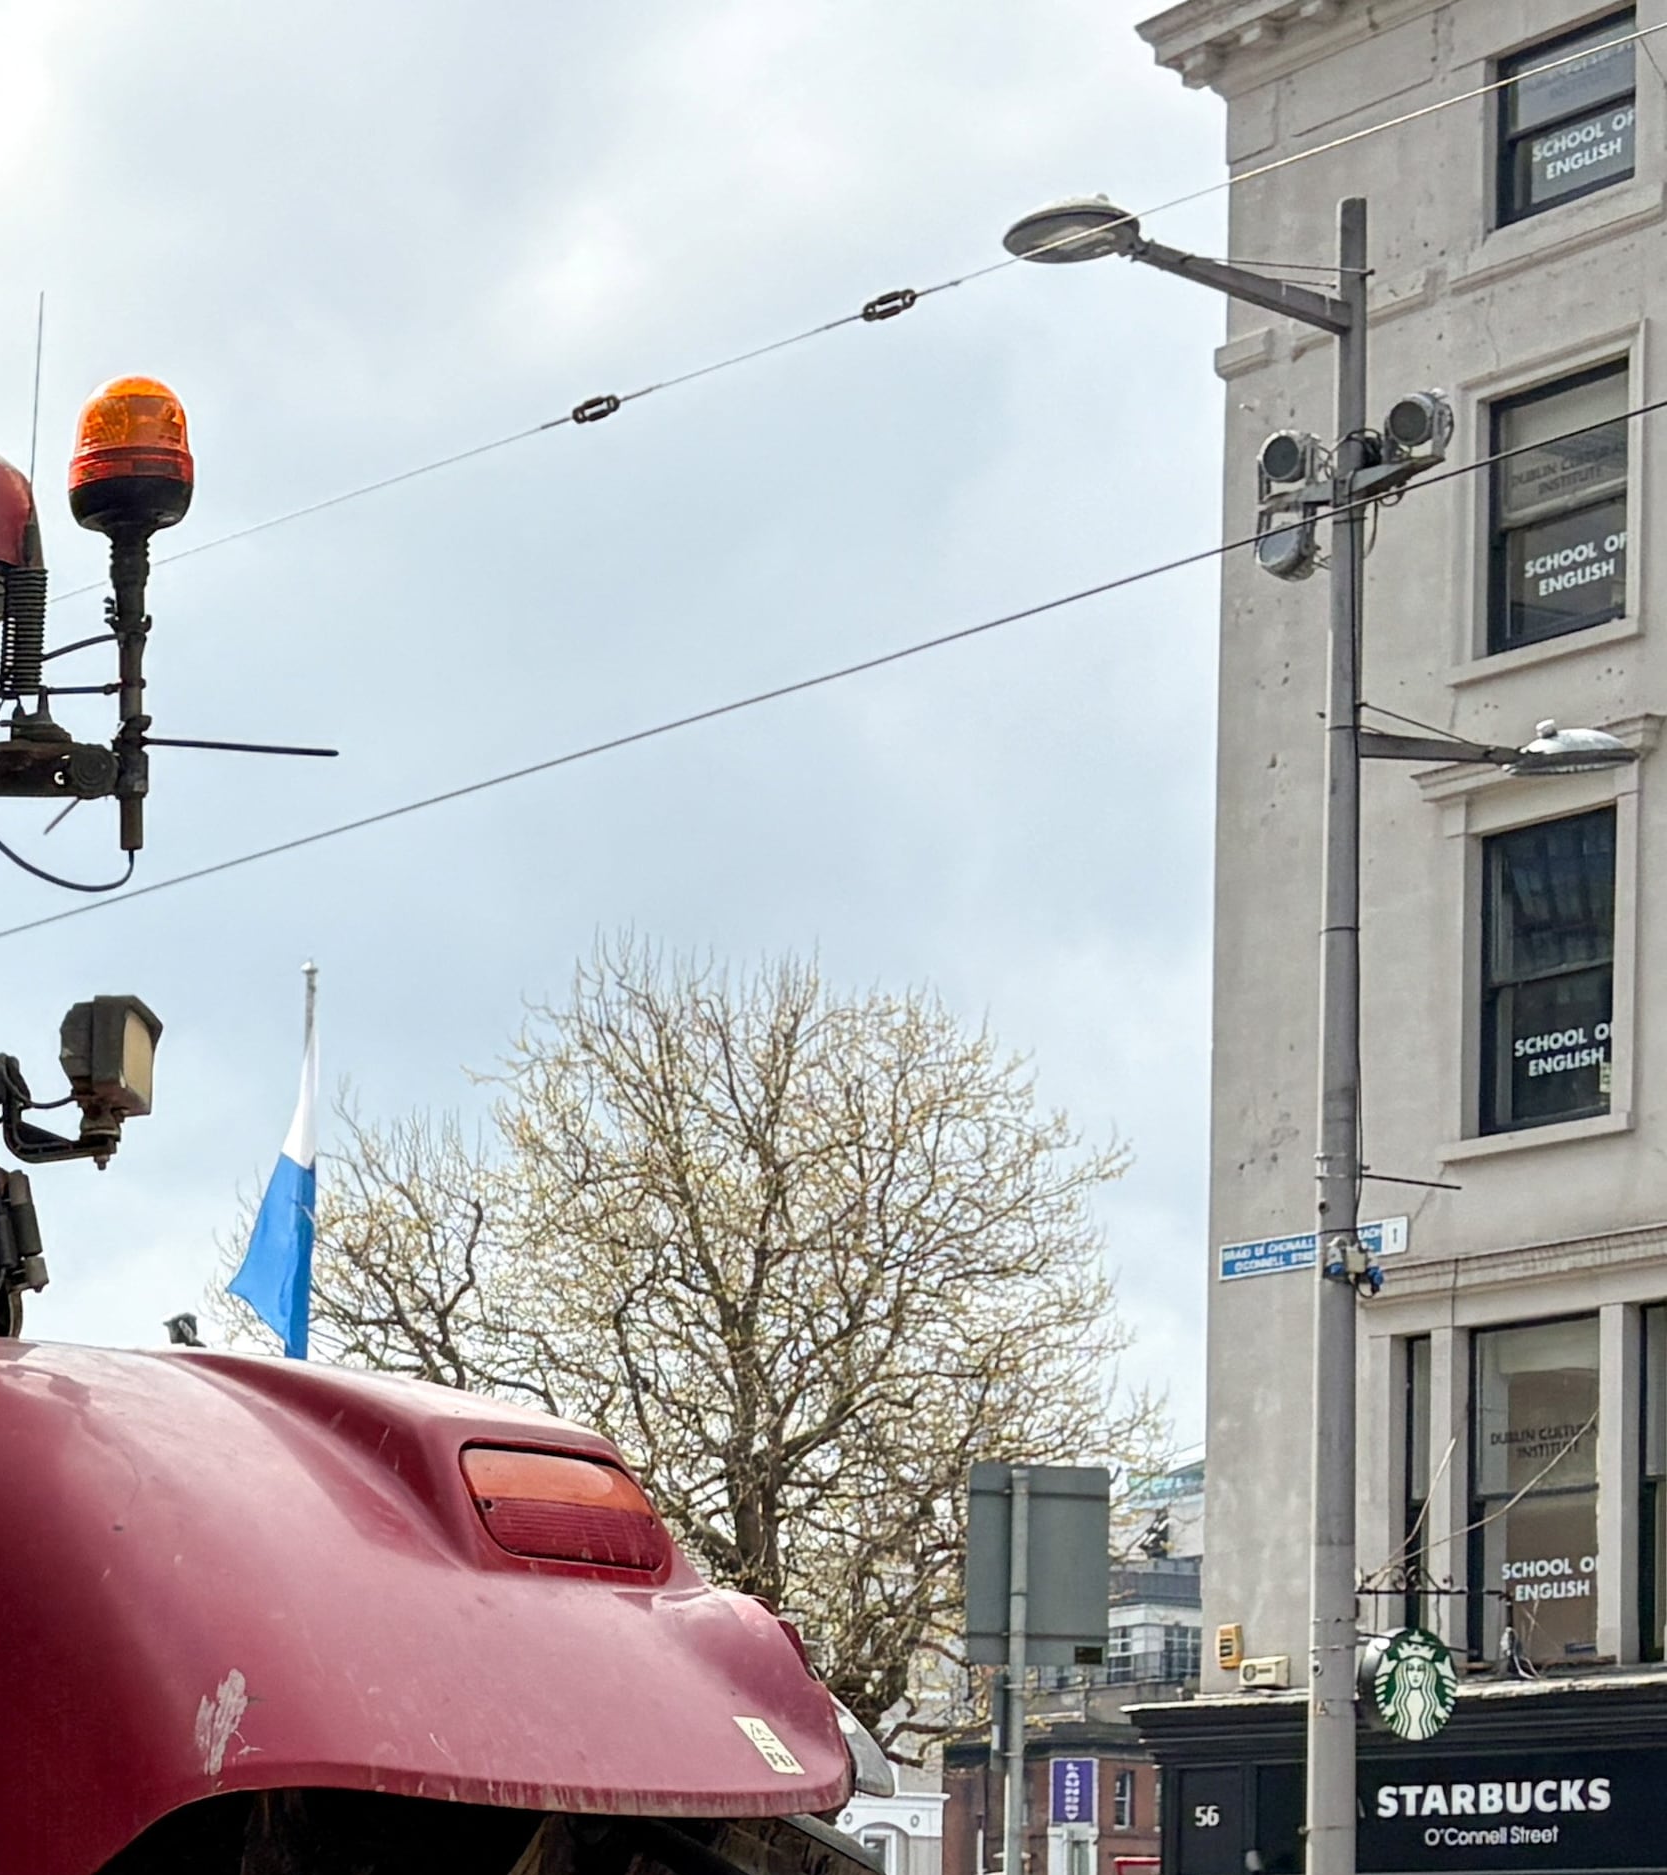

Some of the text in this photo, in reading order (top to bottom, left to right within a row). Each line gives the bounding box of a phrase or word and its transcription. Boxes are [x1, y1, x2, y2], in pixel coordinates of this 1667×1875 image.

[1532, 109, 1634, 162] SCHOOL OF
[1546, 138, 1622, 181] ENGLISH
[1524, 531, 1628, 578] SCHOOL OF
[1538, 558, 1615, 597] ENGLISH
[1514, 1023, 1612, 1057] SCHOOL O
[1528, 1046, 1605, 1077] ENGLISH
[1291, 1252, 1316, 1264] STREE
[1490, 1428, 1537, 1446] DUBLIN
[1501, 1556, 1599, 1580] SCHOOL O
[1515, 1580, 1590, 1602] ENGLISH
[1377, 1778, 1611, 1818] STARBUCKS
[1194, 1805, 1220, 1827] 56
[1424, 1825, 1559, 1846] O'Connell Street
